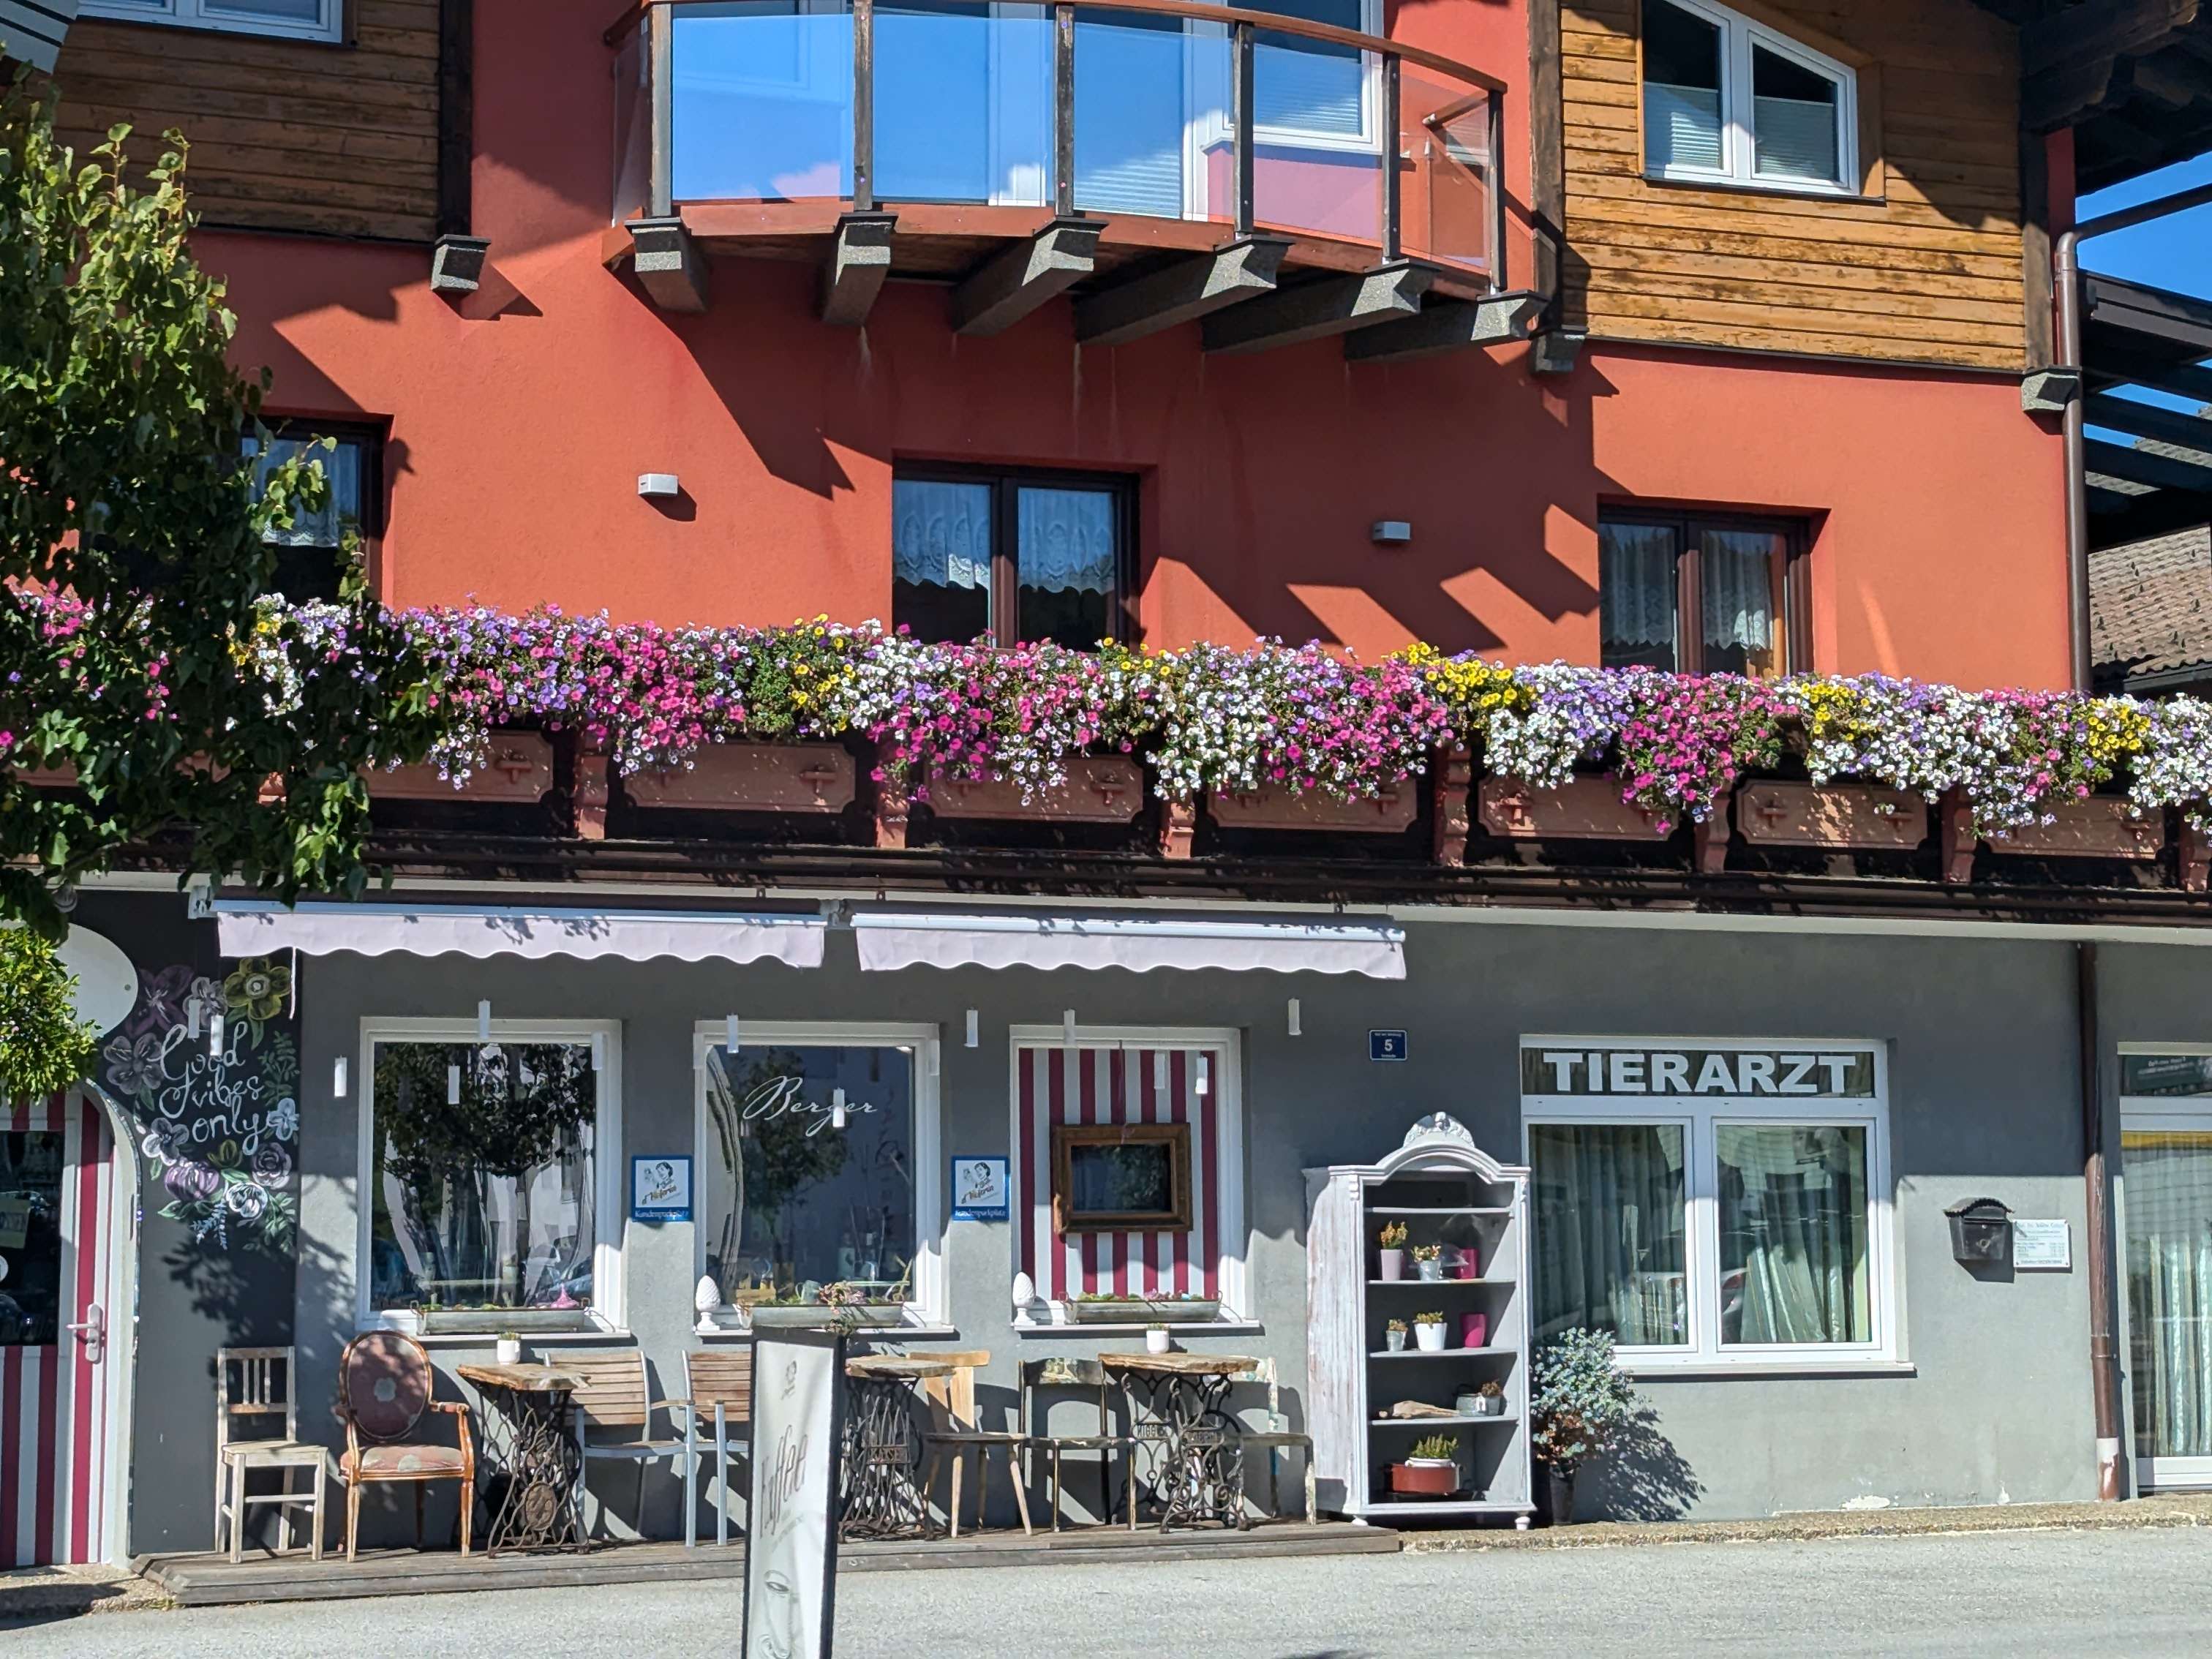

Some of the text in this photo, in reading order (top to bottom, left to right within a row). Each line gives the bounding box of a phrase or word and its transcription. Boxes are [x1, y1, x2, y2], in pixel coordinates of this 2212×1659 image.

[160, 1021, 246, 1118] Good
[1385, 1039, 1393, 1052] 5
[192, 1064, 264, 1107] vibes
[1543, 1053, 1856, 1093] TIERARZT
[192, 1095, 271, 1156] only
[742, 1075, 879, 1137] Berger
